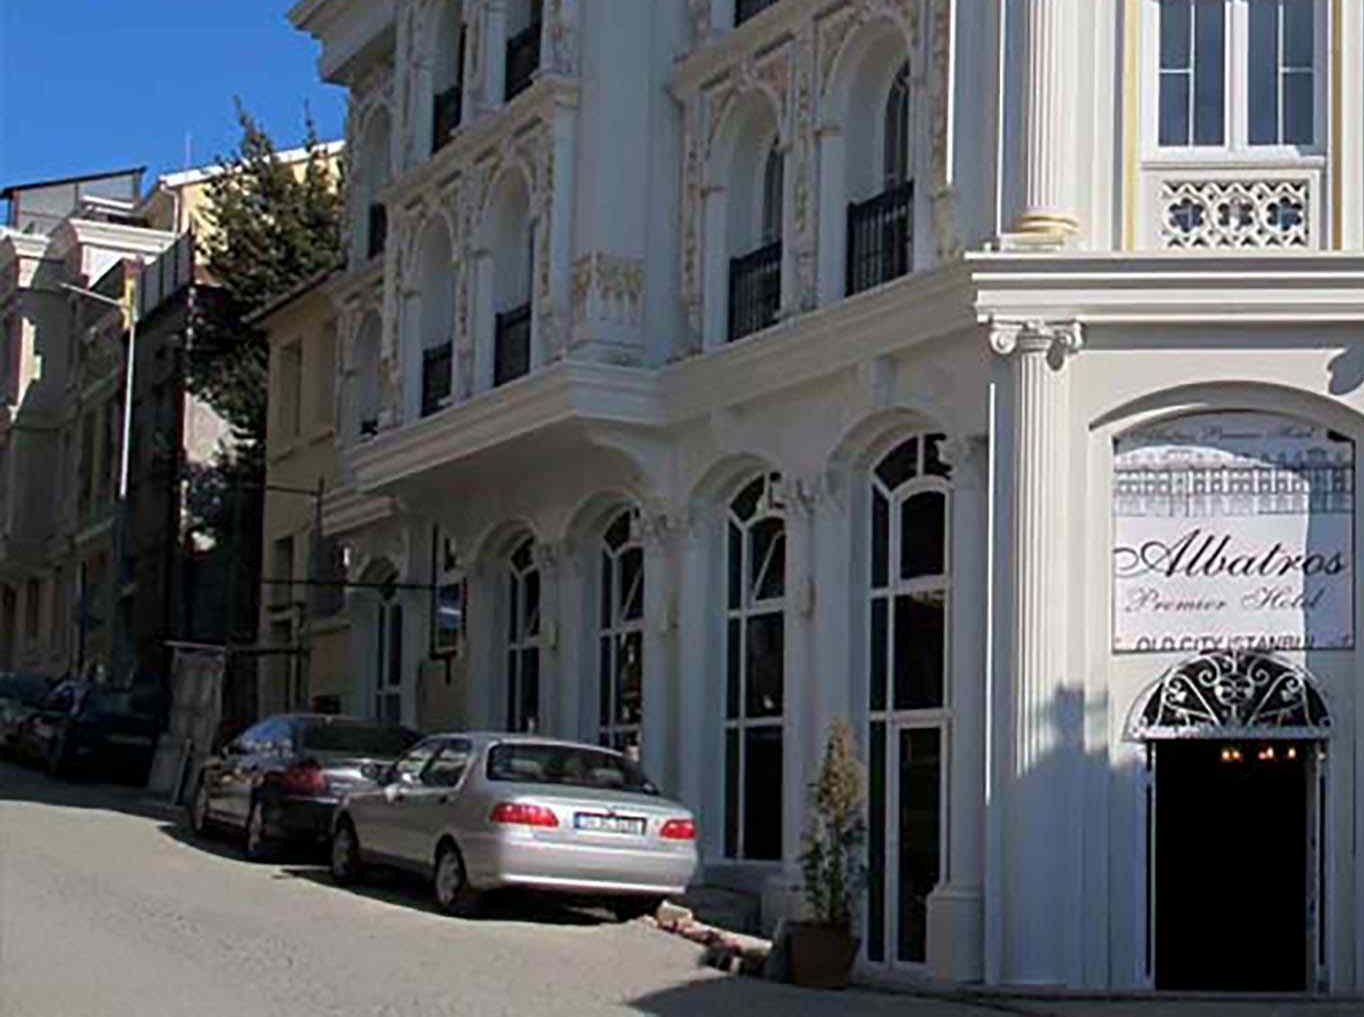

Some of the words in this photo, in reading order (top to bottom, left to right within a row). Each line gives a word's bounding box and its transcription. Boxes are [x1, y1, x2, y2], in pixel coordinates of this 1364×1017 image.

[1113, 529, 1345, 578] Albatros
[1126, 587, 1227, 613] Premier
[1241, 585, 1325, 610] Hotel
